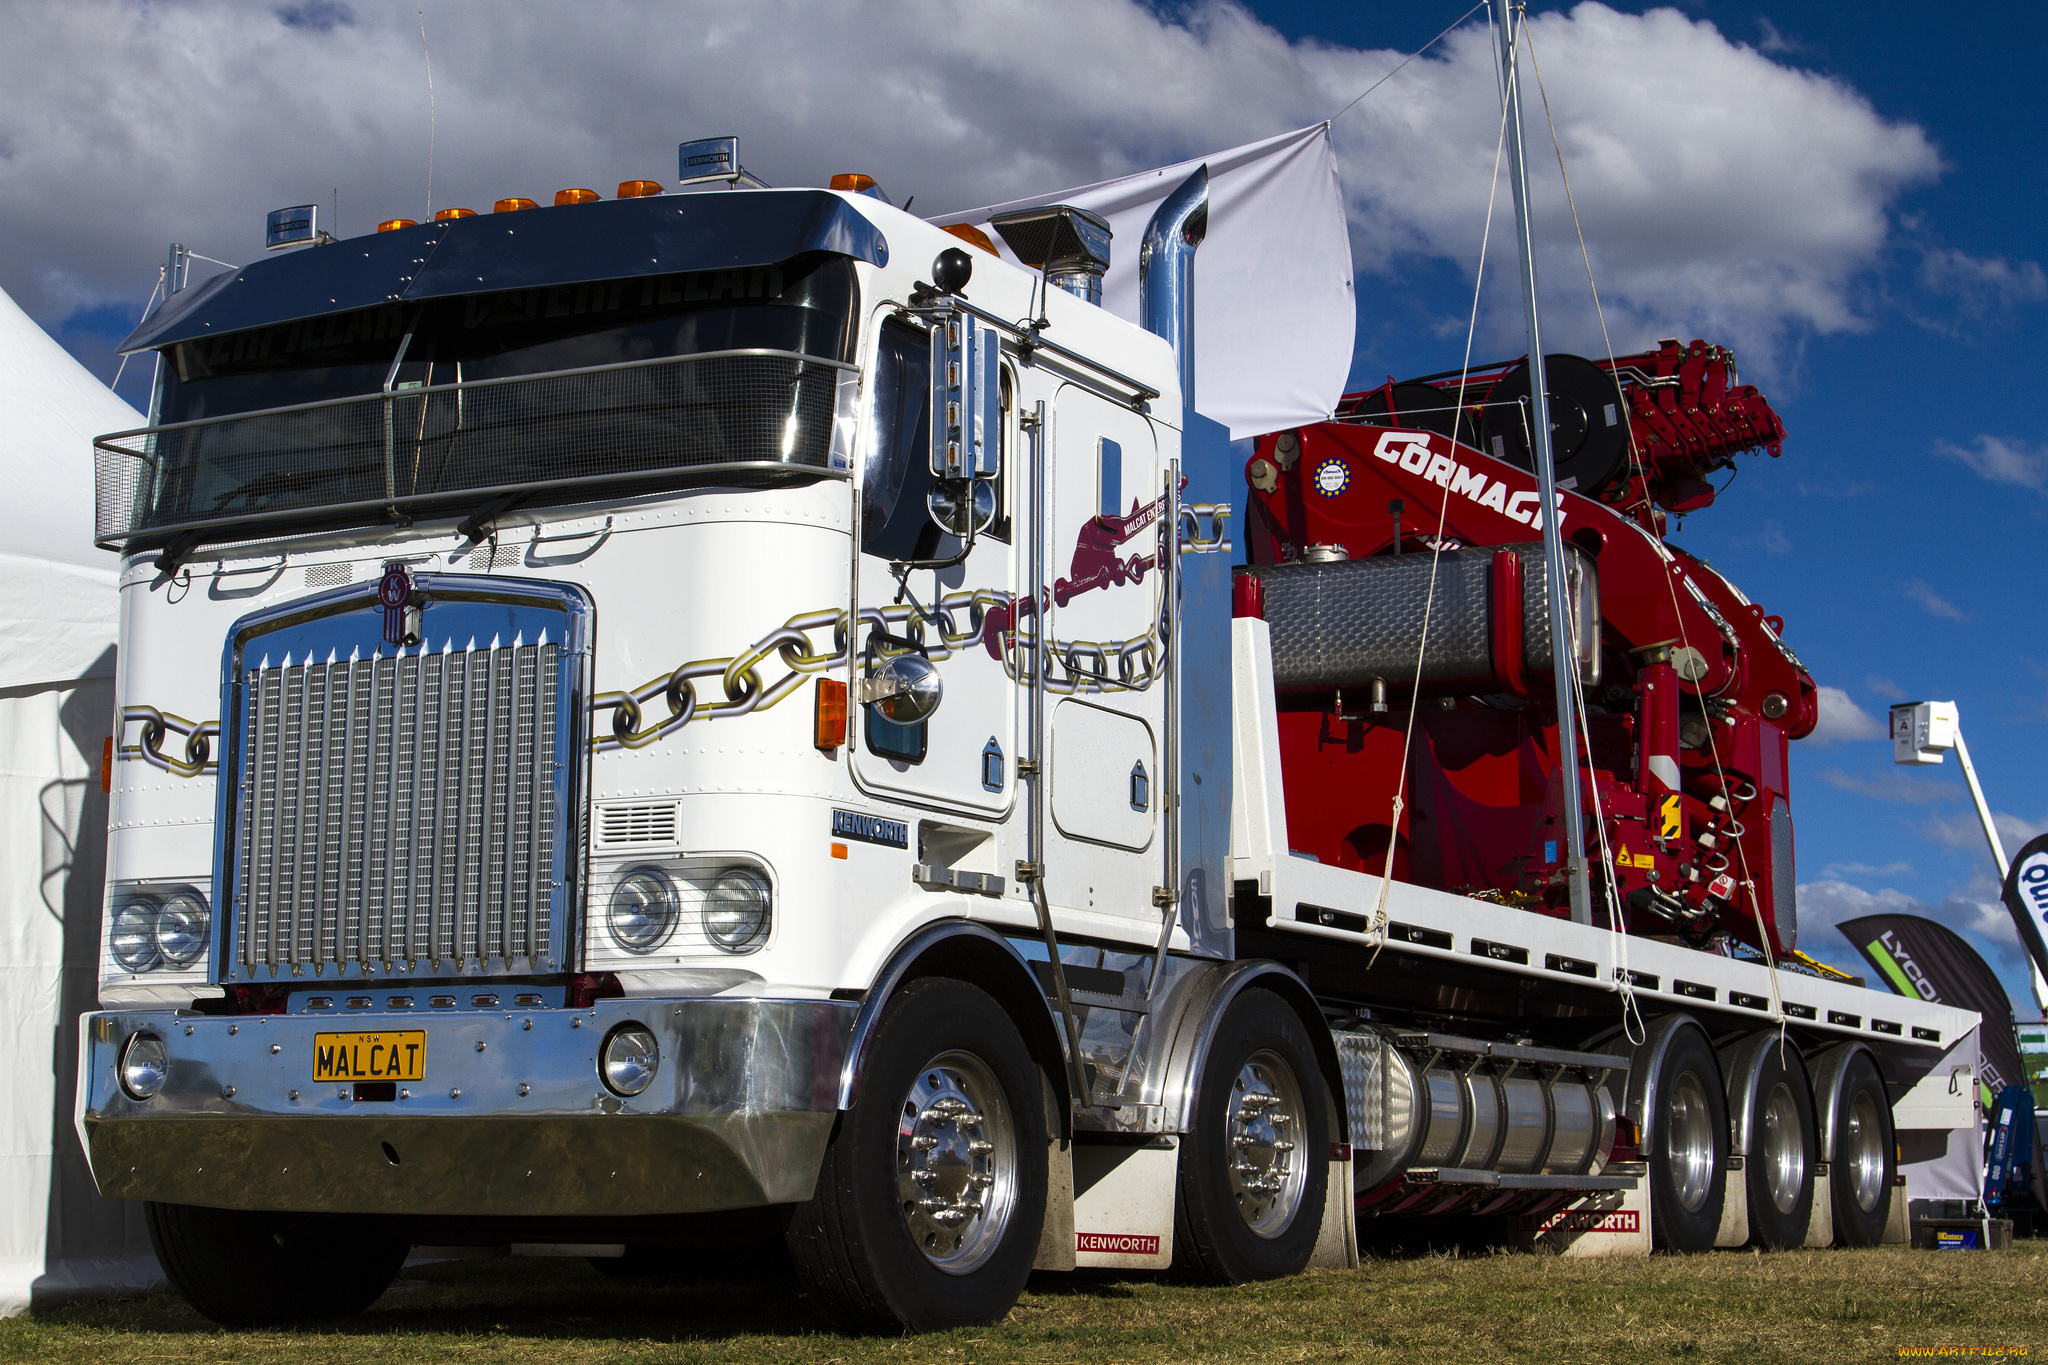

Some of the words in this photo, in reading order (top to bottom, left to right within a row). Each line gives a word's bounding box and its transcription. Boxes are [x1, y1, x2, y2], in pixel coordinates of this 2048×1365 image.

[689, 153, 728, 165] KENWORTH
[274, 220, 308, 232] KENWORTH
[1123, 513, 1147, 537] MALCAT
[833, 809, 909, 844] KENWORTH
[317, 1044, 420, 1077] MALCAT
[1540, 1213, 1636, 1230] KENWORTH
[1080, 1236, 1157, 1252] KENWORTH
